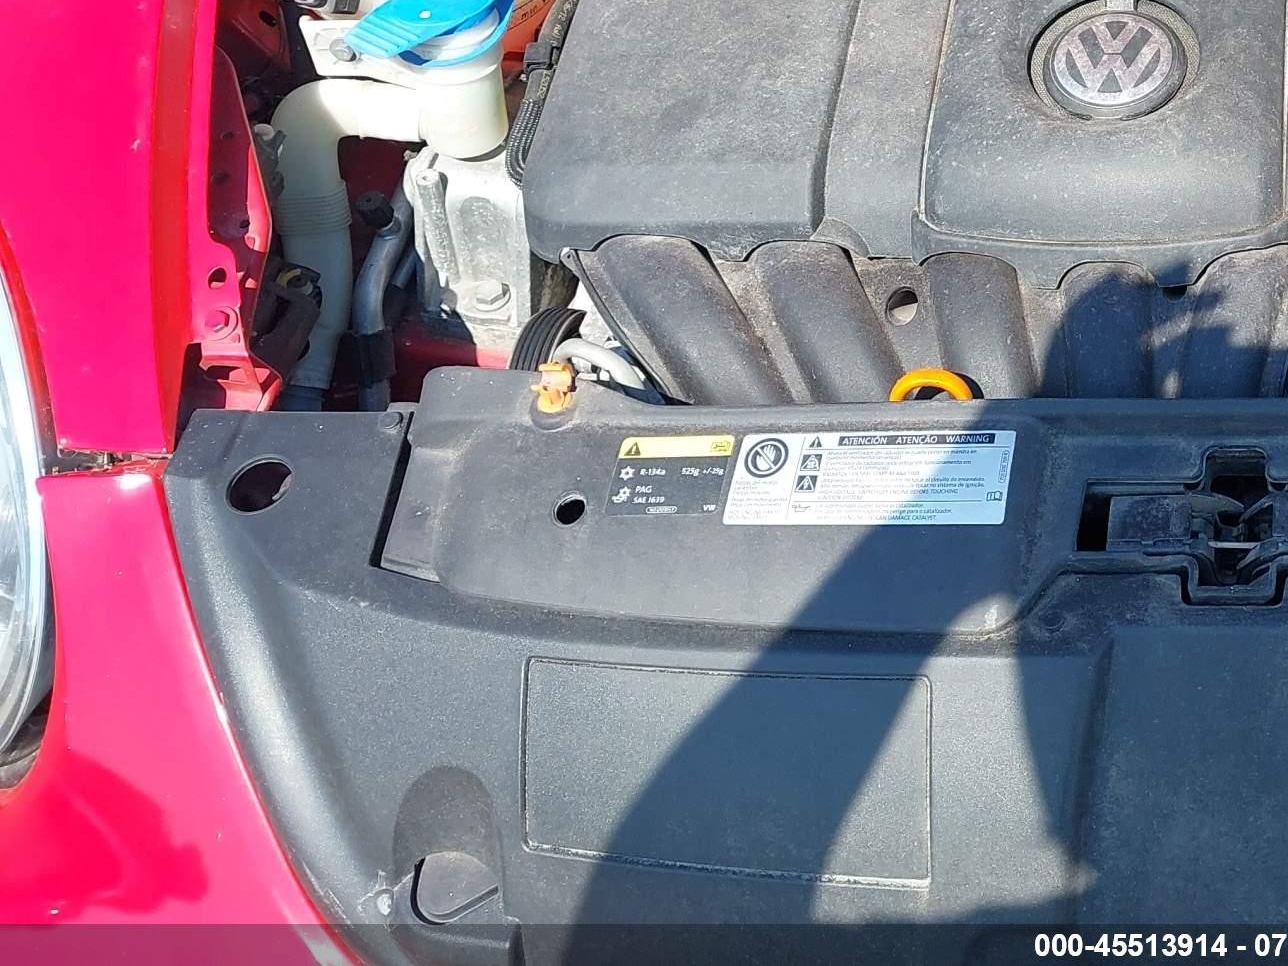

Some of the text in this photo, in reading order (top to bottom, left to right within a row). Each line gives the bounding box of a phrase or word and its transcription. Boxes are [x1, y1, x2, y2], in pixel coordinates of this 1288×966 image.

[842, 435, 888, 445] ATENCIÓN
[946, 434, 990, 444] WARNING
[640, 468, 666, 476] R-134a
[682, 468, 700, 477] 525g
